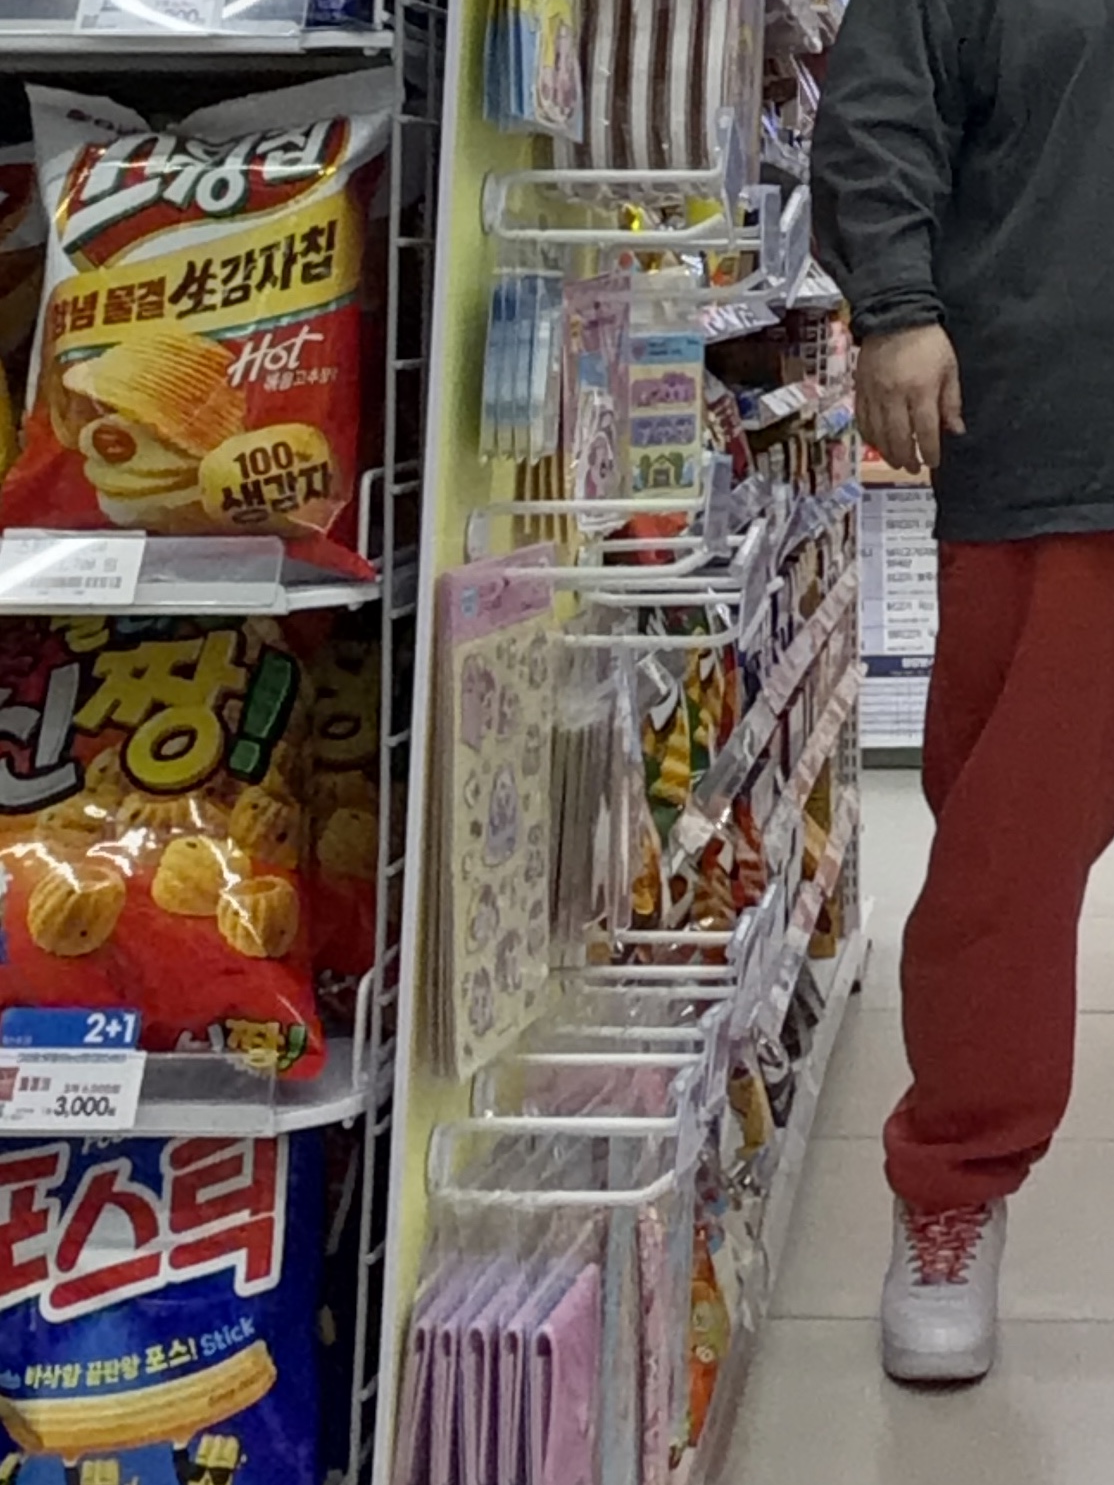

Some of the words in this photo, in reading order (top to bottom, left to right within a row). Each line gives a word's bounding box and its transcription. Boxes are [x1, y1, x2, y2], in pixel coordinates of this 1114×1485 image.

[227, 324, 325, 388] Hot
[221, 460, 331, 524] 생감자
[83, 1012, 137, 1044] 2+1
[145, 1337, 199, 1375] 포스!
[200, 1317, 256, 1357] Stick
